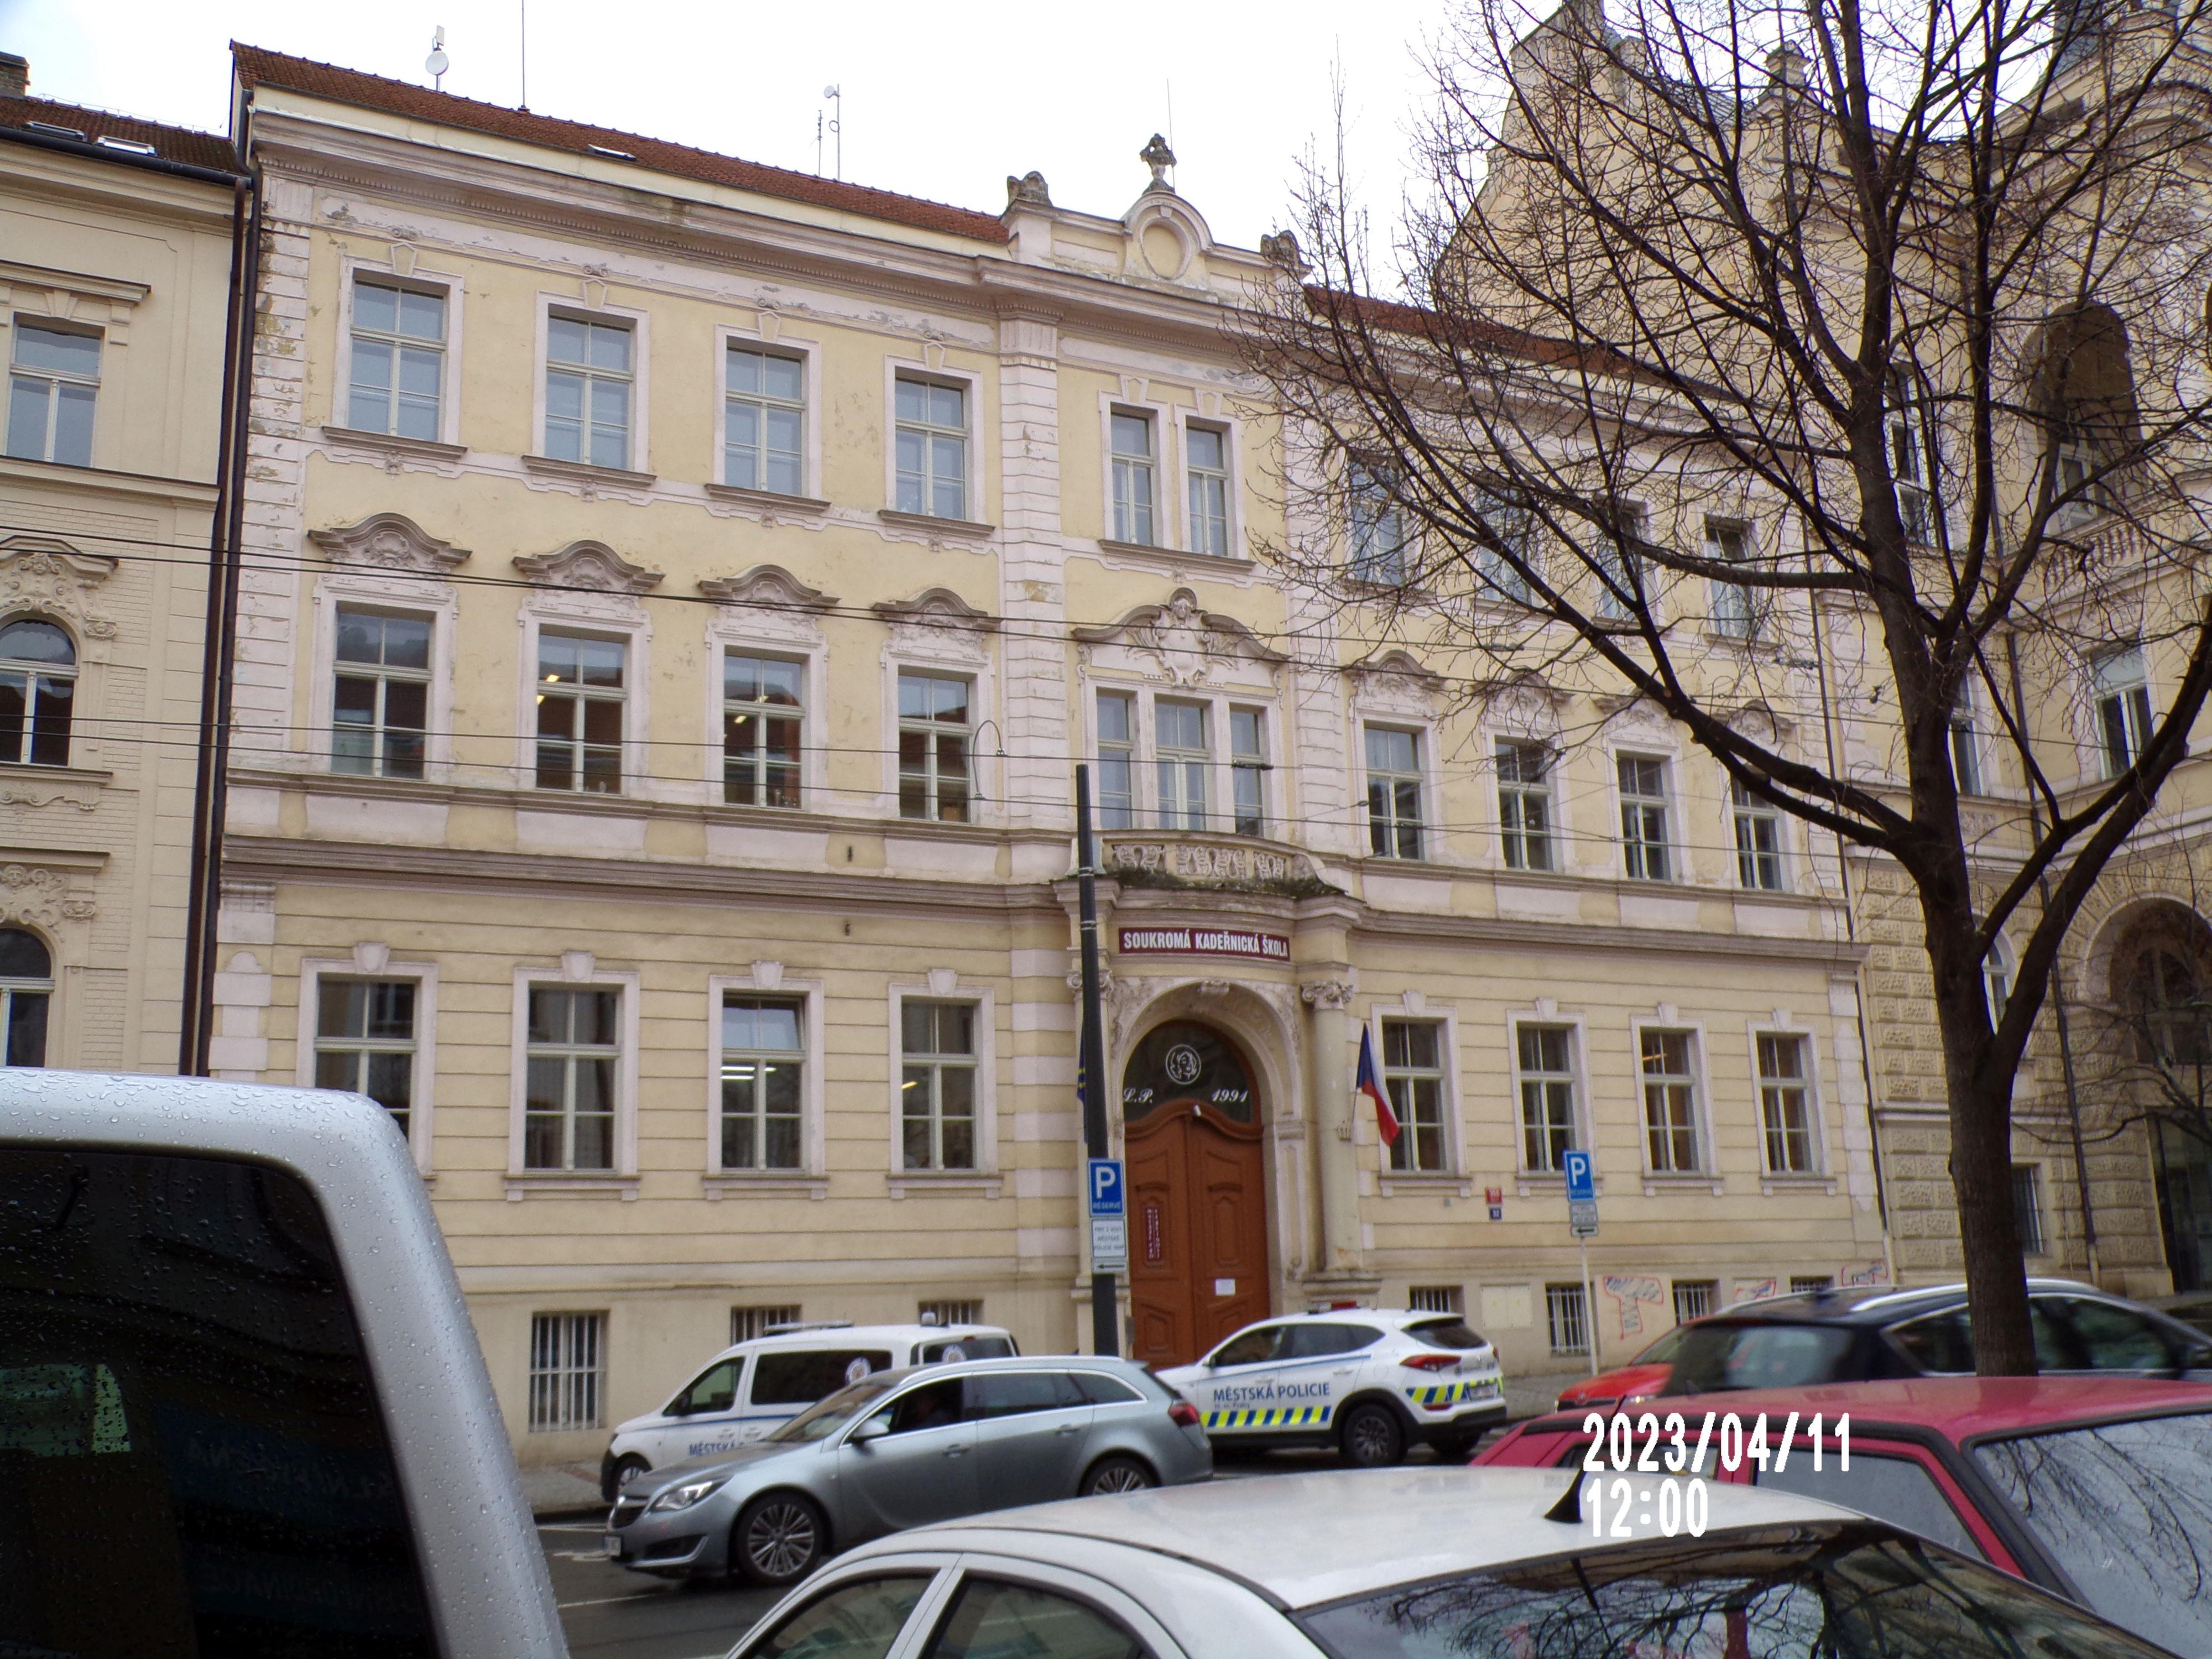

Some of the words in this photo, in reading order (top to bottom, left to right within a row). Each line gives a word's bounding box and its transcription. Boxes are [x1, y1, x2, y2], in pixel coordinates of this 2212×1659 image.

[1124, 929, 1191, 949] SOUKROMÁ
[1196, 931, 1260, 953] KADEŘNICKÁ
[1262, 935, 1288, 957] ŠKOLA
[1212, 1089, 1248, 1103] 1991
[1095, 1166, 1116, 1199] P
[1571, 1157, 1586, 1186] P
[1213, 1384, 1275, 1402] MĚSTSKÁ
[1279, 1382, 1330, 1399] POLICIE
